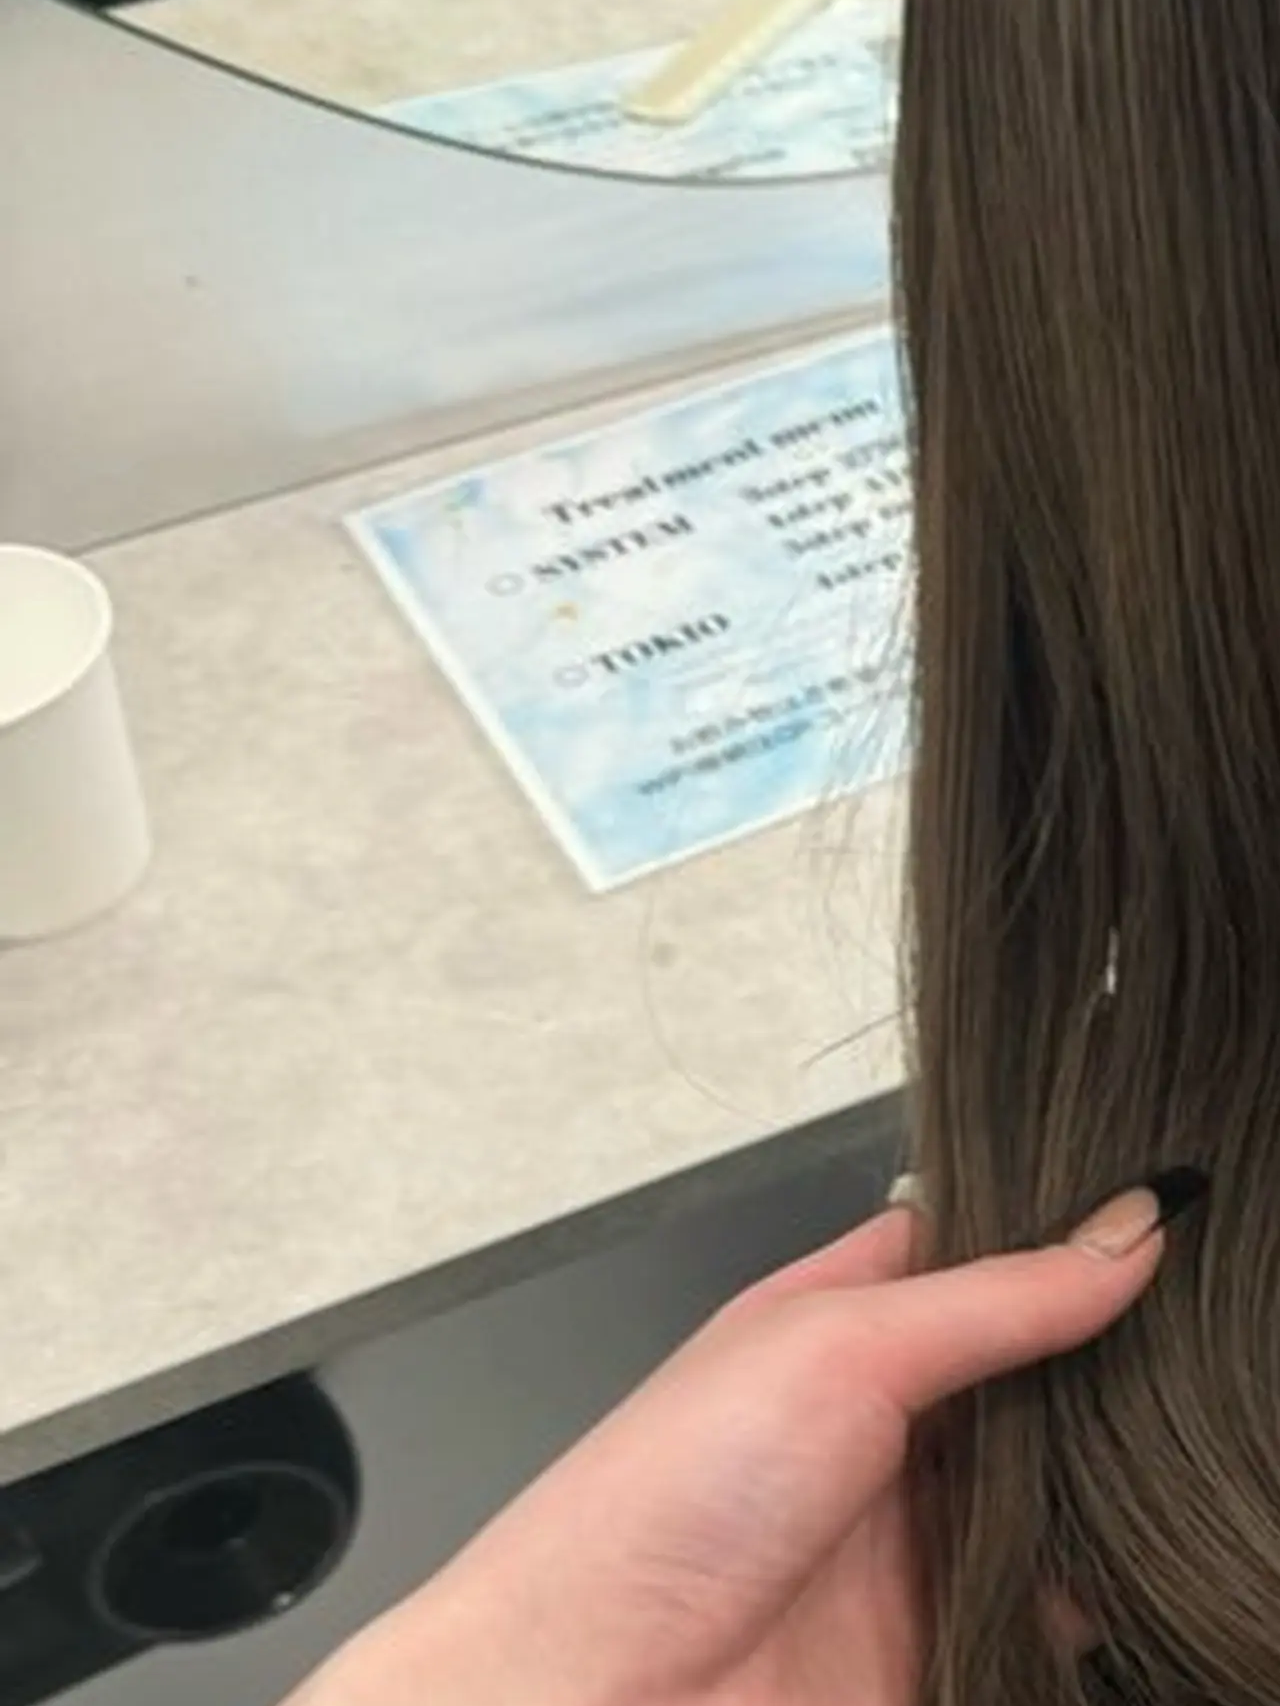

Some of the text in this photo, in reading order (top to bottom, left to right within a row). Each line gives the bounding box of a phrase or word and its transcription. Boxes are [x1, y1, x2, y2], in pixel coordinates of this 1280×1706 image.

[541, 435, 763, 524] Treatment
[530, 513, 696, 583] SYSTEM
[590, 612, 731, 675] TOKIO
